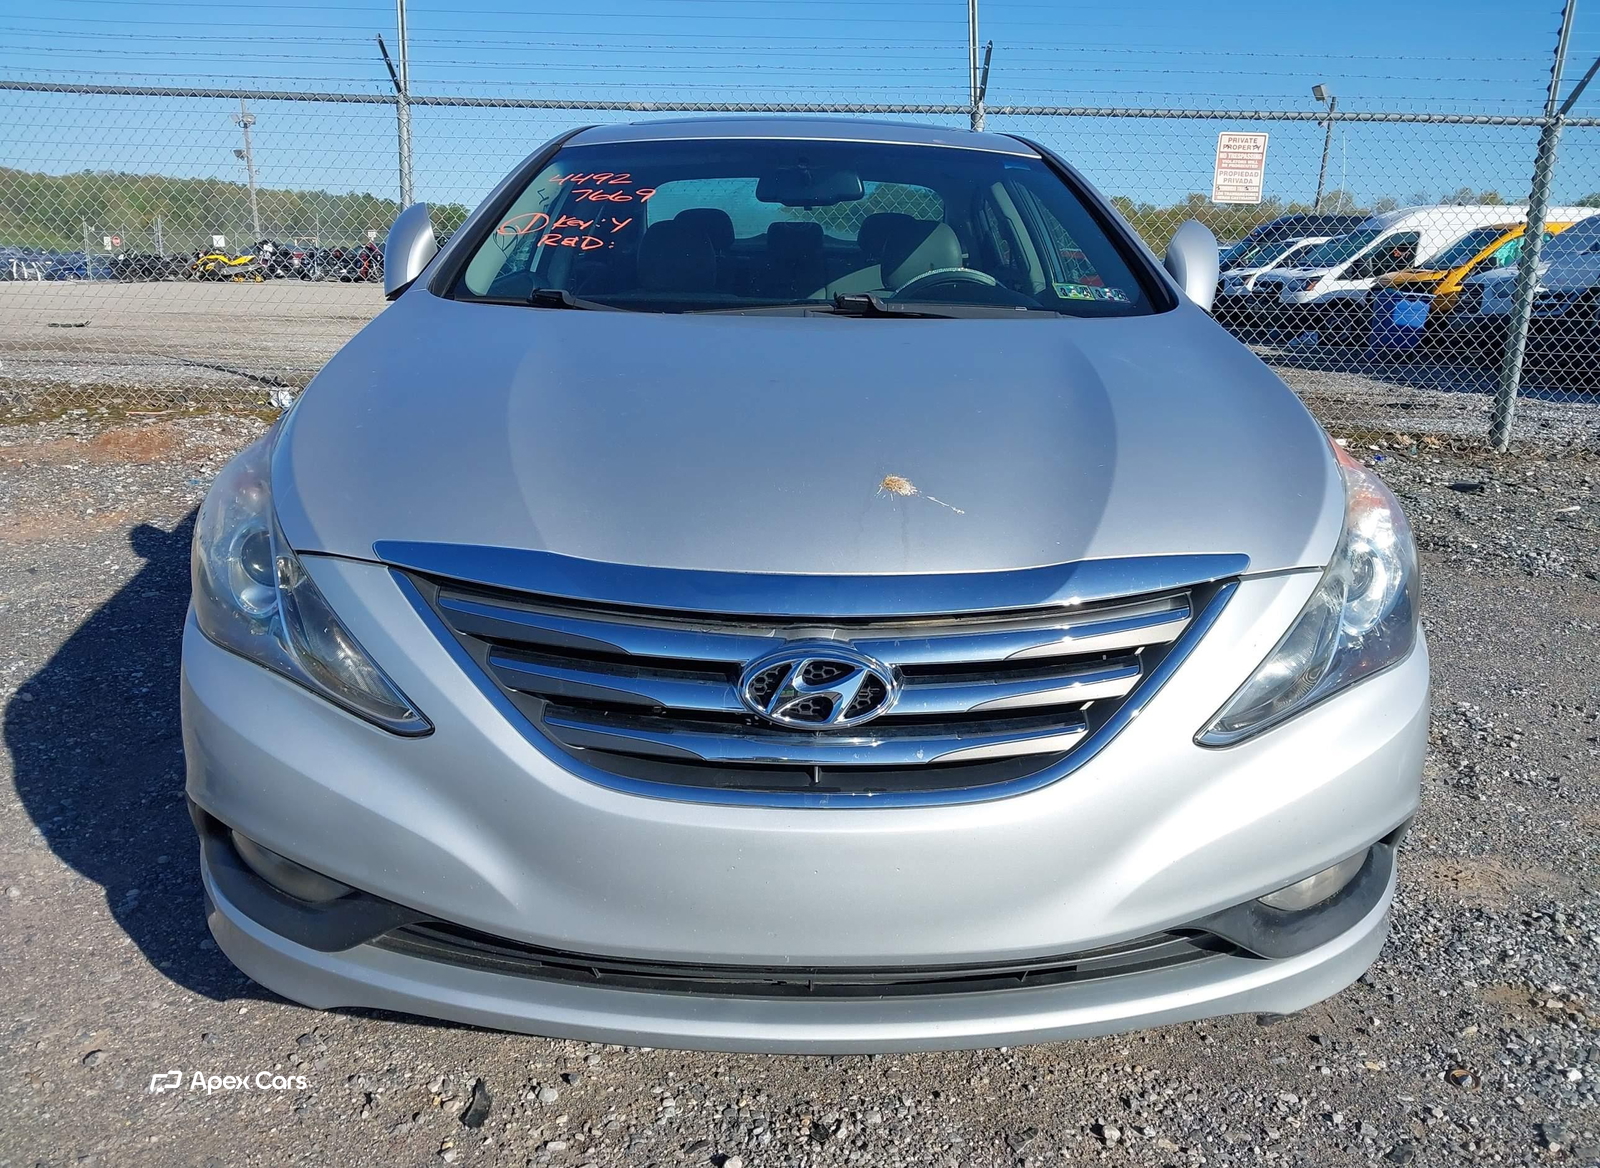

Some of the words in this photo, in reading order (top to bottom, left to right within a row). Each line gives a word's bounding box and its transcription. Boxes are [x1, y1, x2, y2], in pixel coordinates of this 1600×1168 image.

[549, 172, 633, 185] 4492
[1218, 170, 1259, 178] PROPIEDAD
[571, 188, 656, 203] 7669
